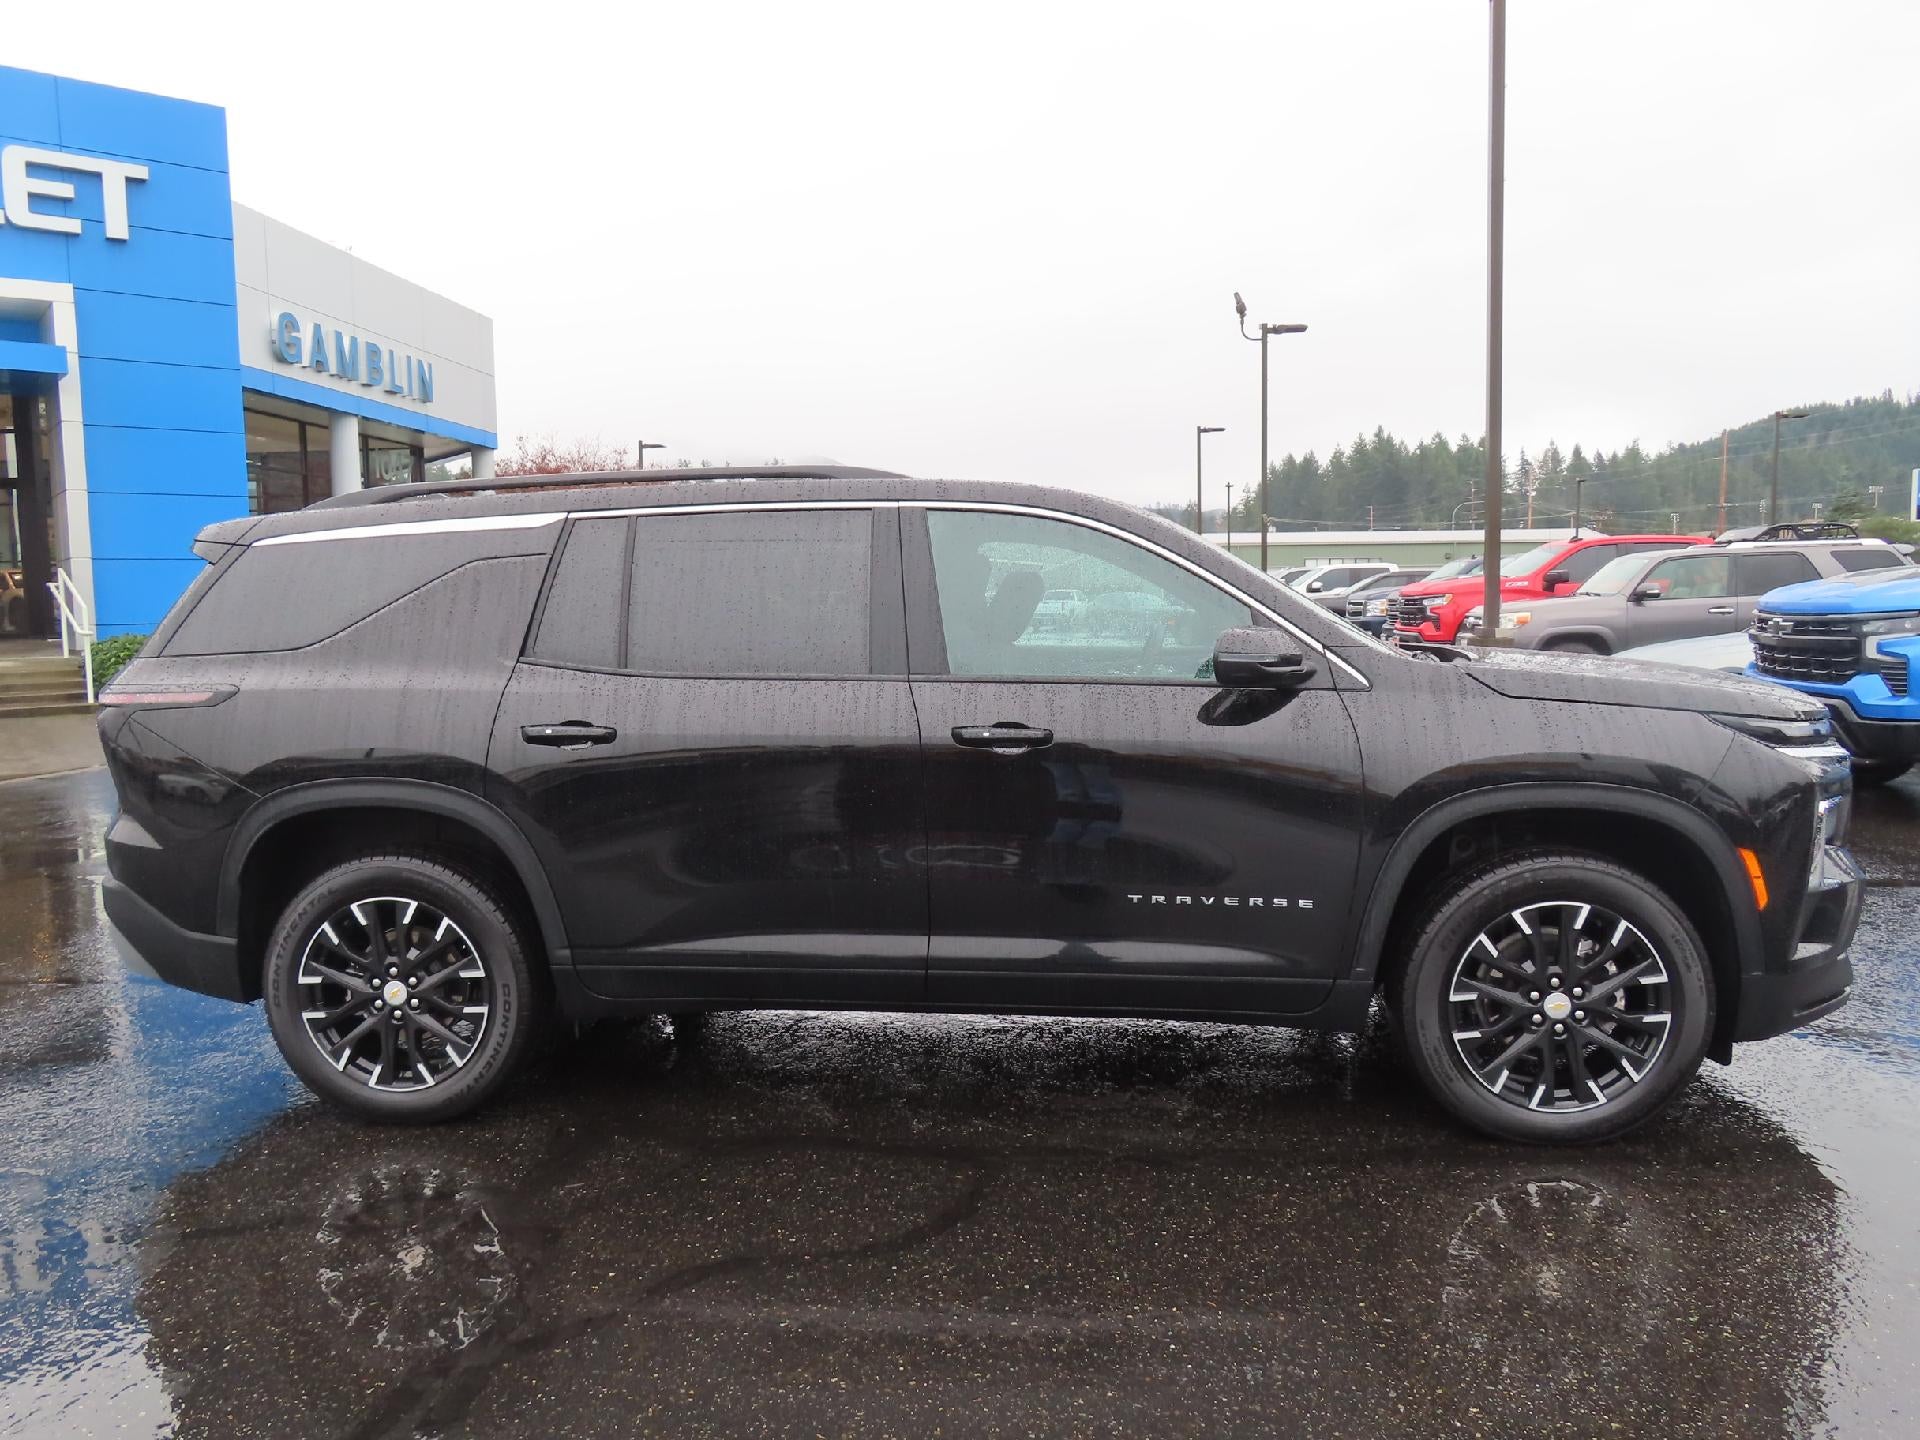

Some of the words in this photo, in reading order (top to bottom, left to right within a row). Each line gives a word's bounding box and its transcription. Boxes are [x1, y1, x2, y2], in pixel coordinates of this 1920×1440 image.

[0, 144, 149, 239] ET
[273, 311, 434, 403] GAMBLIN
[1127, 894, 1314, 909] TRAVERSE
